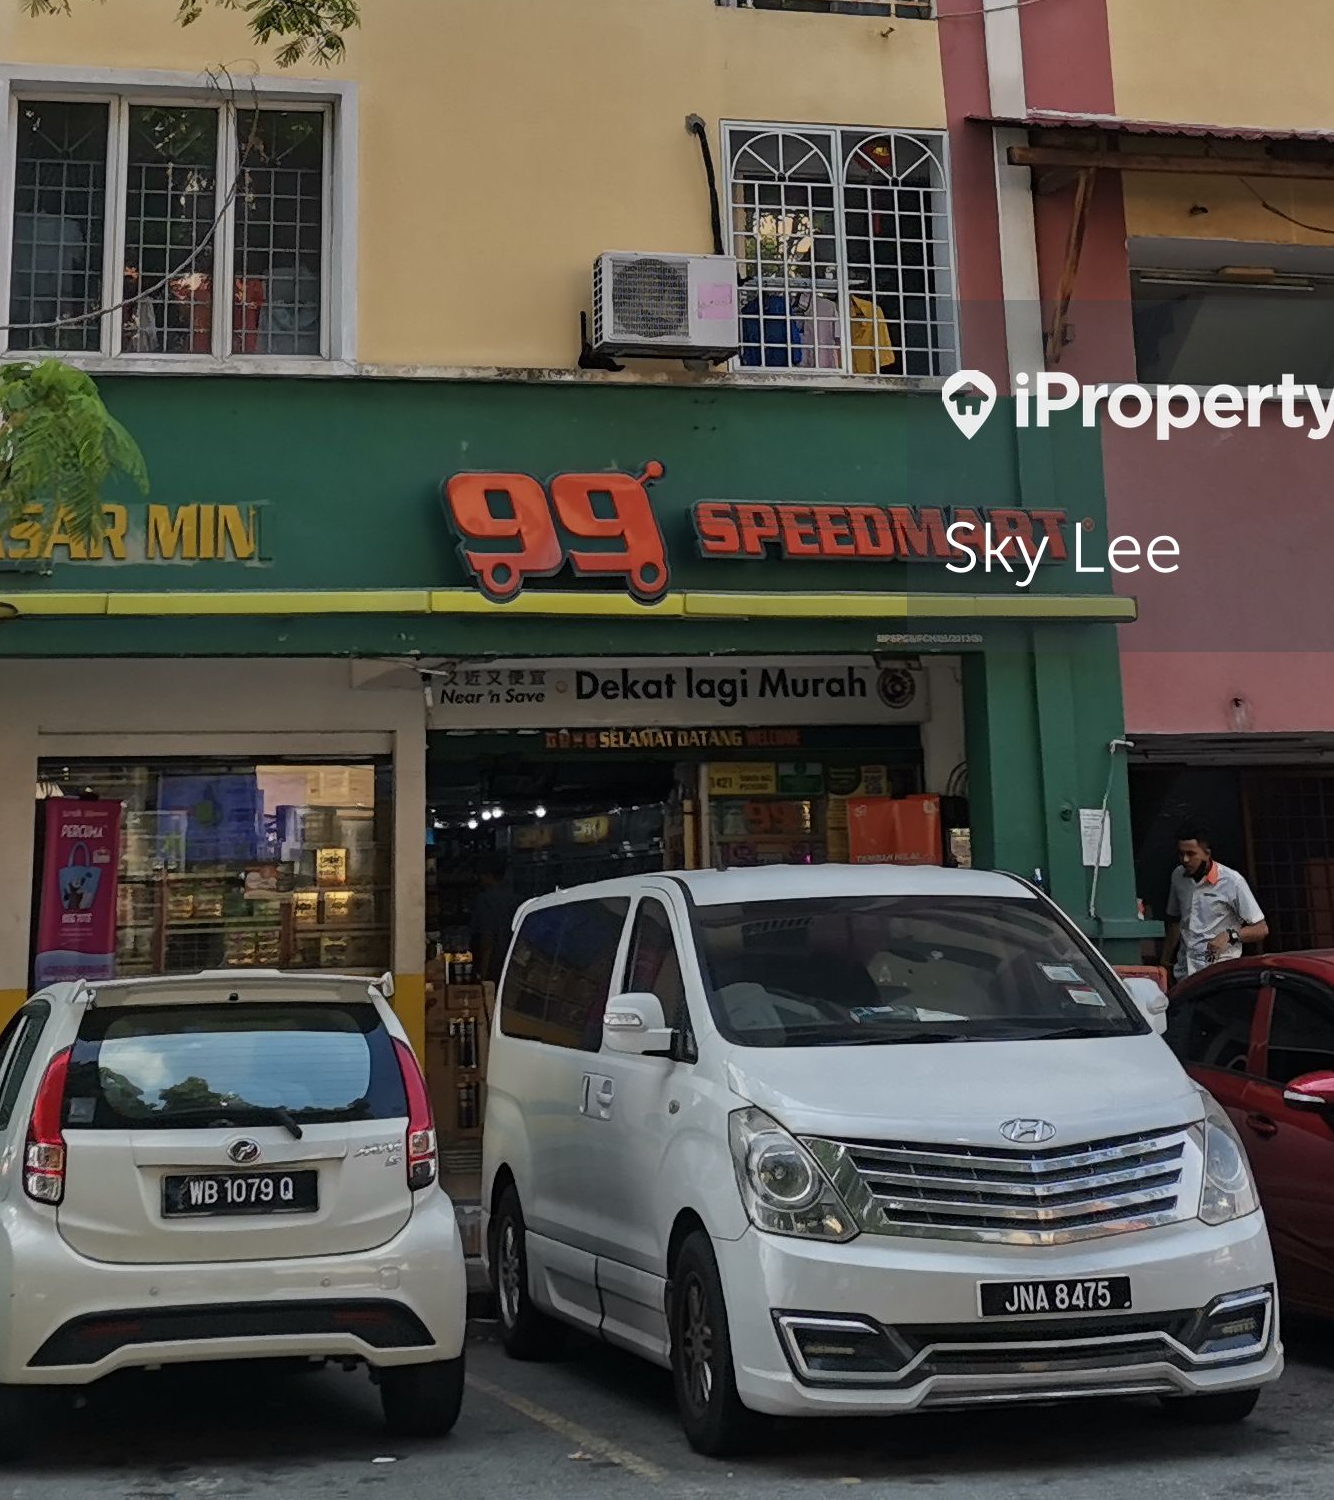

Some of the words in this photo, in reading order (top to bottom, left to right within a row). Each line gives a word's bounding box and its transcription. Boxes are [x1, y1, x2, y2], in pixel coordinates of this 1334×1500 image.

[447, 460, 666, 594] 99
[694, 501, 1068, 560] SPEEDMART
[441, 689, 482, 704] Near
[505, 688, 545, 704] Save
[576, 667, 676, 700] Dekat
[686, 666, 748, 707] lagi
[759, 666, 867, 698] Murah
[599, 730, 673, 748] SELAMAT
[677, 729, 743, 748] DATANG
[189, 1179, 218, 1205] WB
[224, 1176, 273, 1202] 1079
[280, 1176, 294, 1200] Q
[1005, 1284, 1049, 1312] JNA
[1055, 1281, 1111, 1309] 8475
